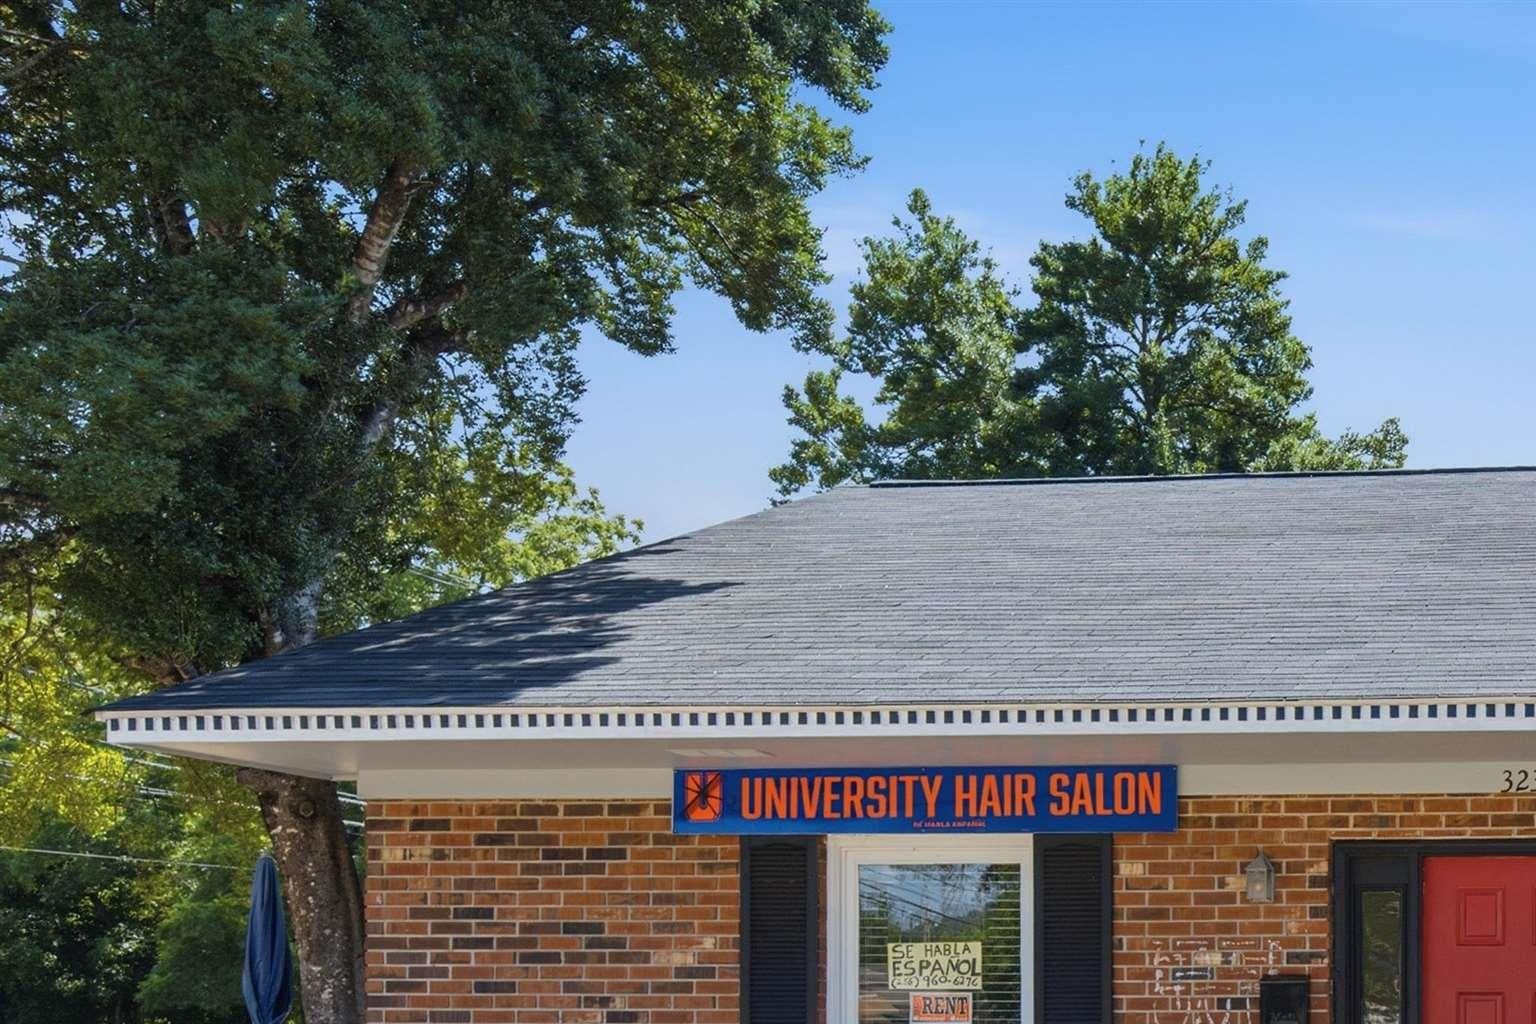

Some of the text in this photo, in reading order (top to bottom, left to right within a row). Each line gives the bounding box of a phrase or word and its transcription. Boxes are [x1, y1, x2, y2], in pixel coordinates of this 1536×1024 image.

[740, 771, 1162, 820] UNIVERSITY HAIR SALON
[892, 943, 972, 960] SE HABLA
[892, 956, 982, 976] ESPAÑOL
[922, 996, 968, 1015] RENT
